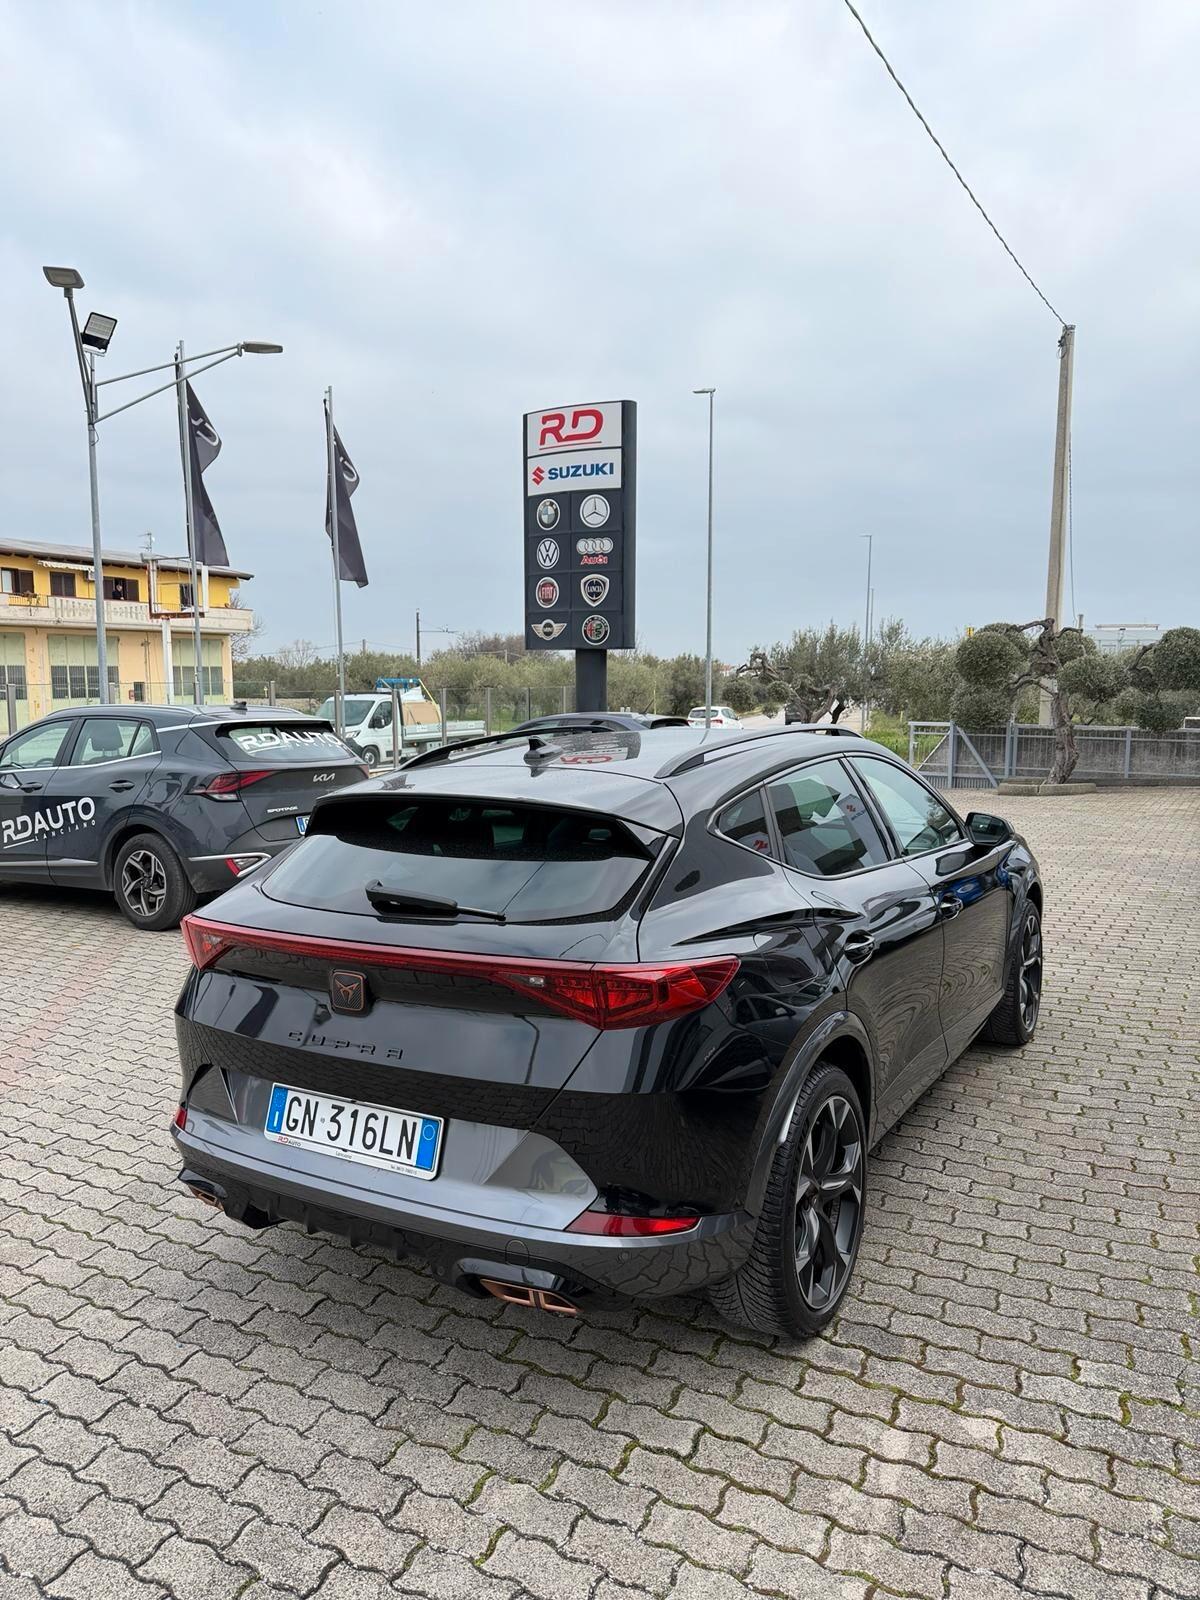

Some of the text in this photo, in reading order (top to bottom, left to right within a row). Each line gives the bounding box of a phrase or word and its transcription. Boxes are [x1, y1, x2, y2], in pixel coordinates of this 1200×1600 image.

[540, 409, 603, 446] RD
[548, 462, 614, 480] SUZUKI
[580, 555, 608, 565] Audi
[541, 587, 554, 598] FIAT
[313, 773, 335, 782] KIA
[35, 819, 96, 842] LANCIANO
[288, 1032, 403, 1060] CUPRA
